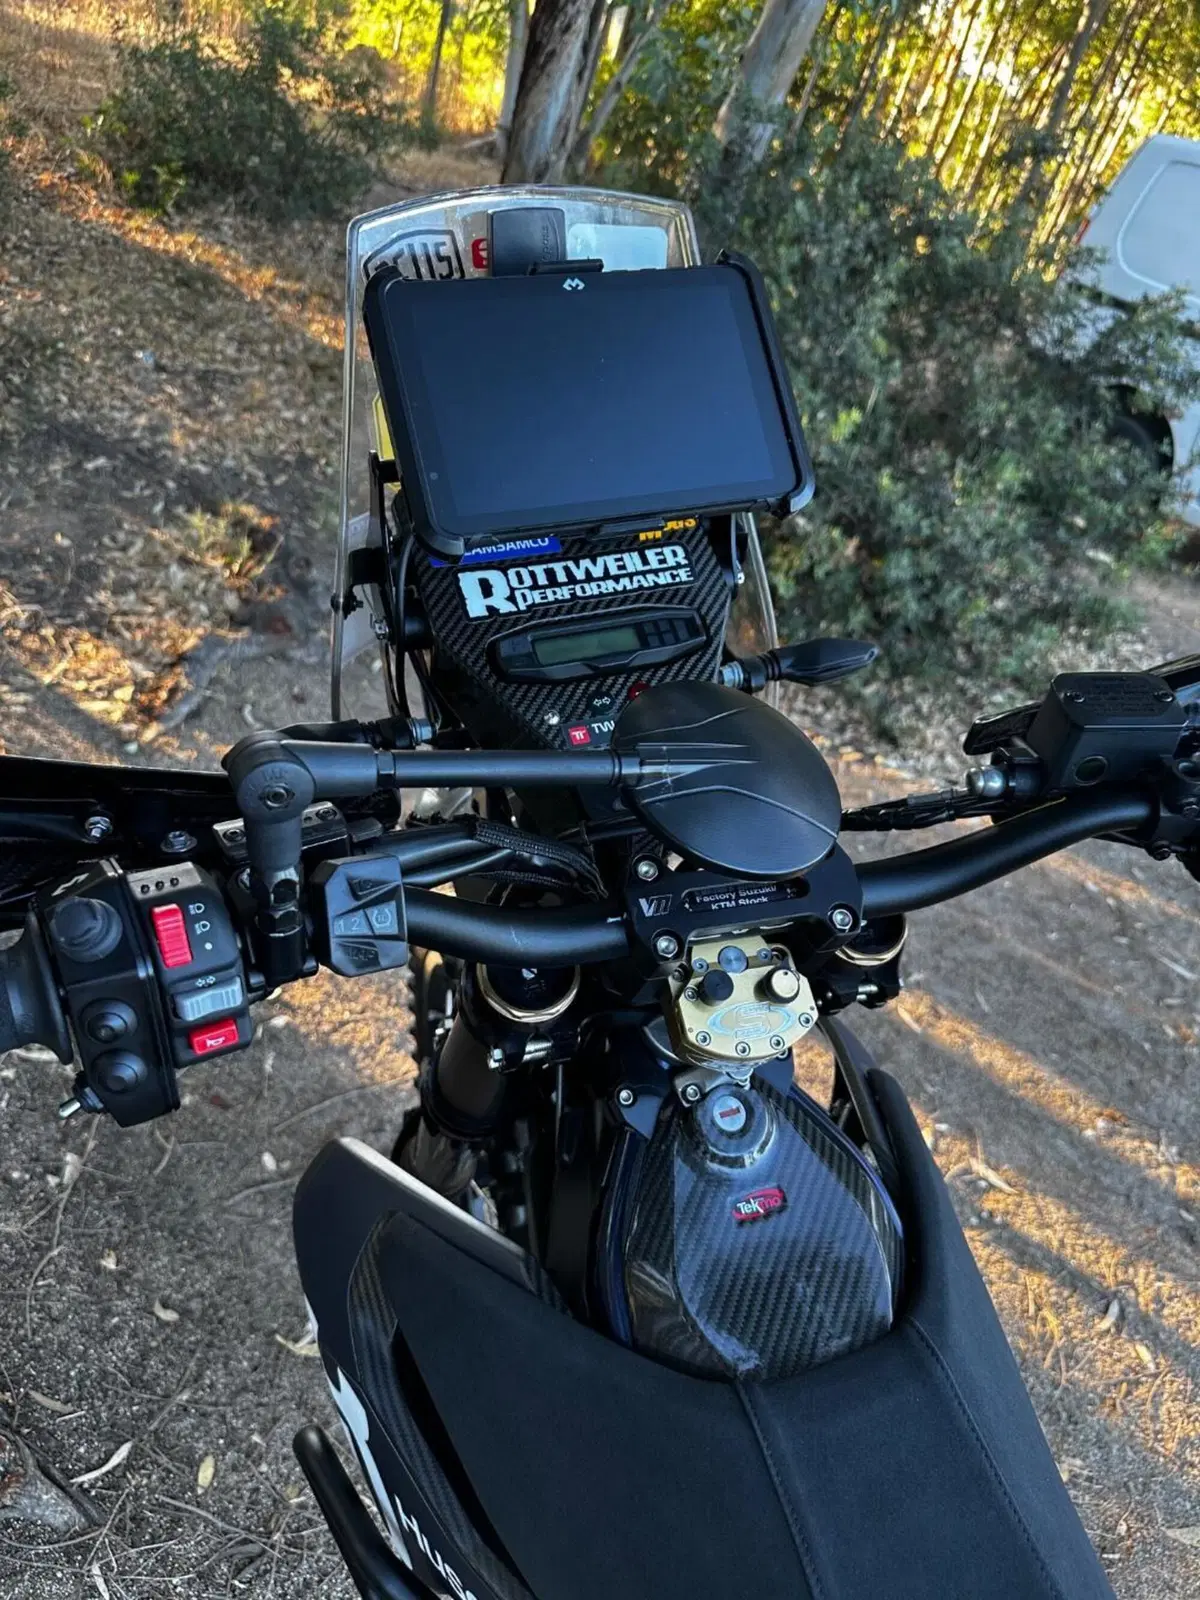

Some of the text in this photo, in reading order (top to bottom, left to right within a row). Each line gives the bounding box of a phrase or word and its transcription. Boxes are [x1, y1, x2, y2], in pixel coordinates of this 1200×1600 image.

[457, 545, 688, 618] ROTTWEILER
[515, 566, 694, 610] PERFORMANCE
[695, 891, 737, 904] Factory
[711, 901, 736, 910] KTM
[736, 1197, 783, 1214] Tekmo
[394, 1493, 478, 1600] HUS
